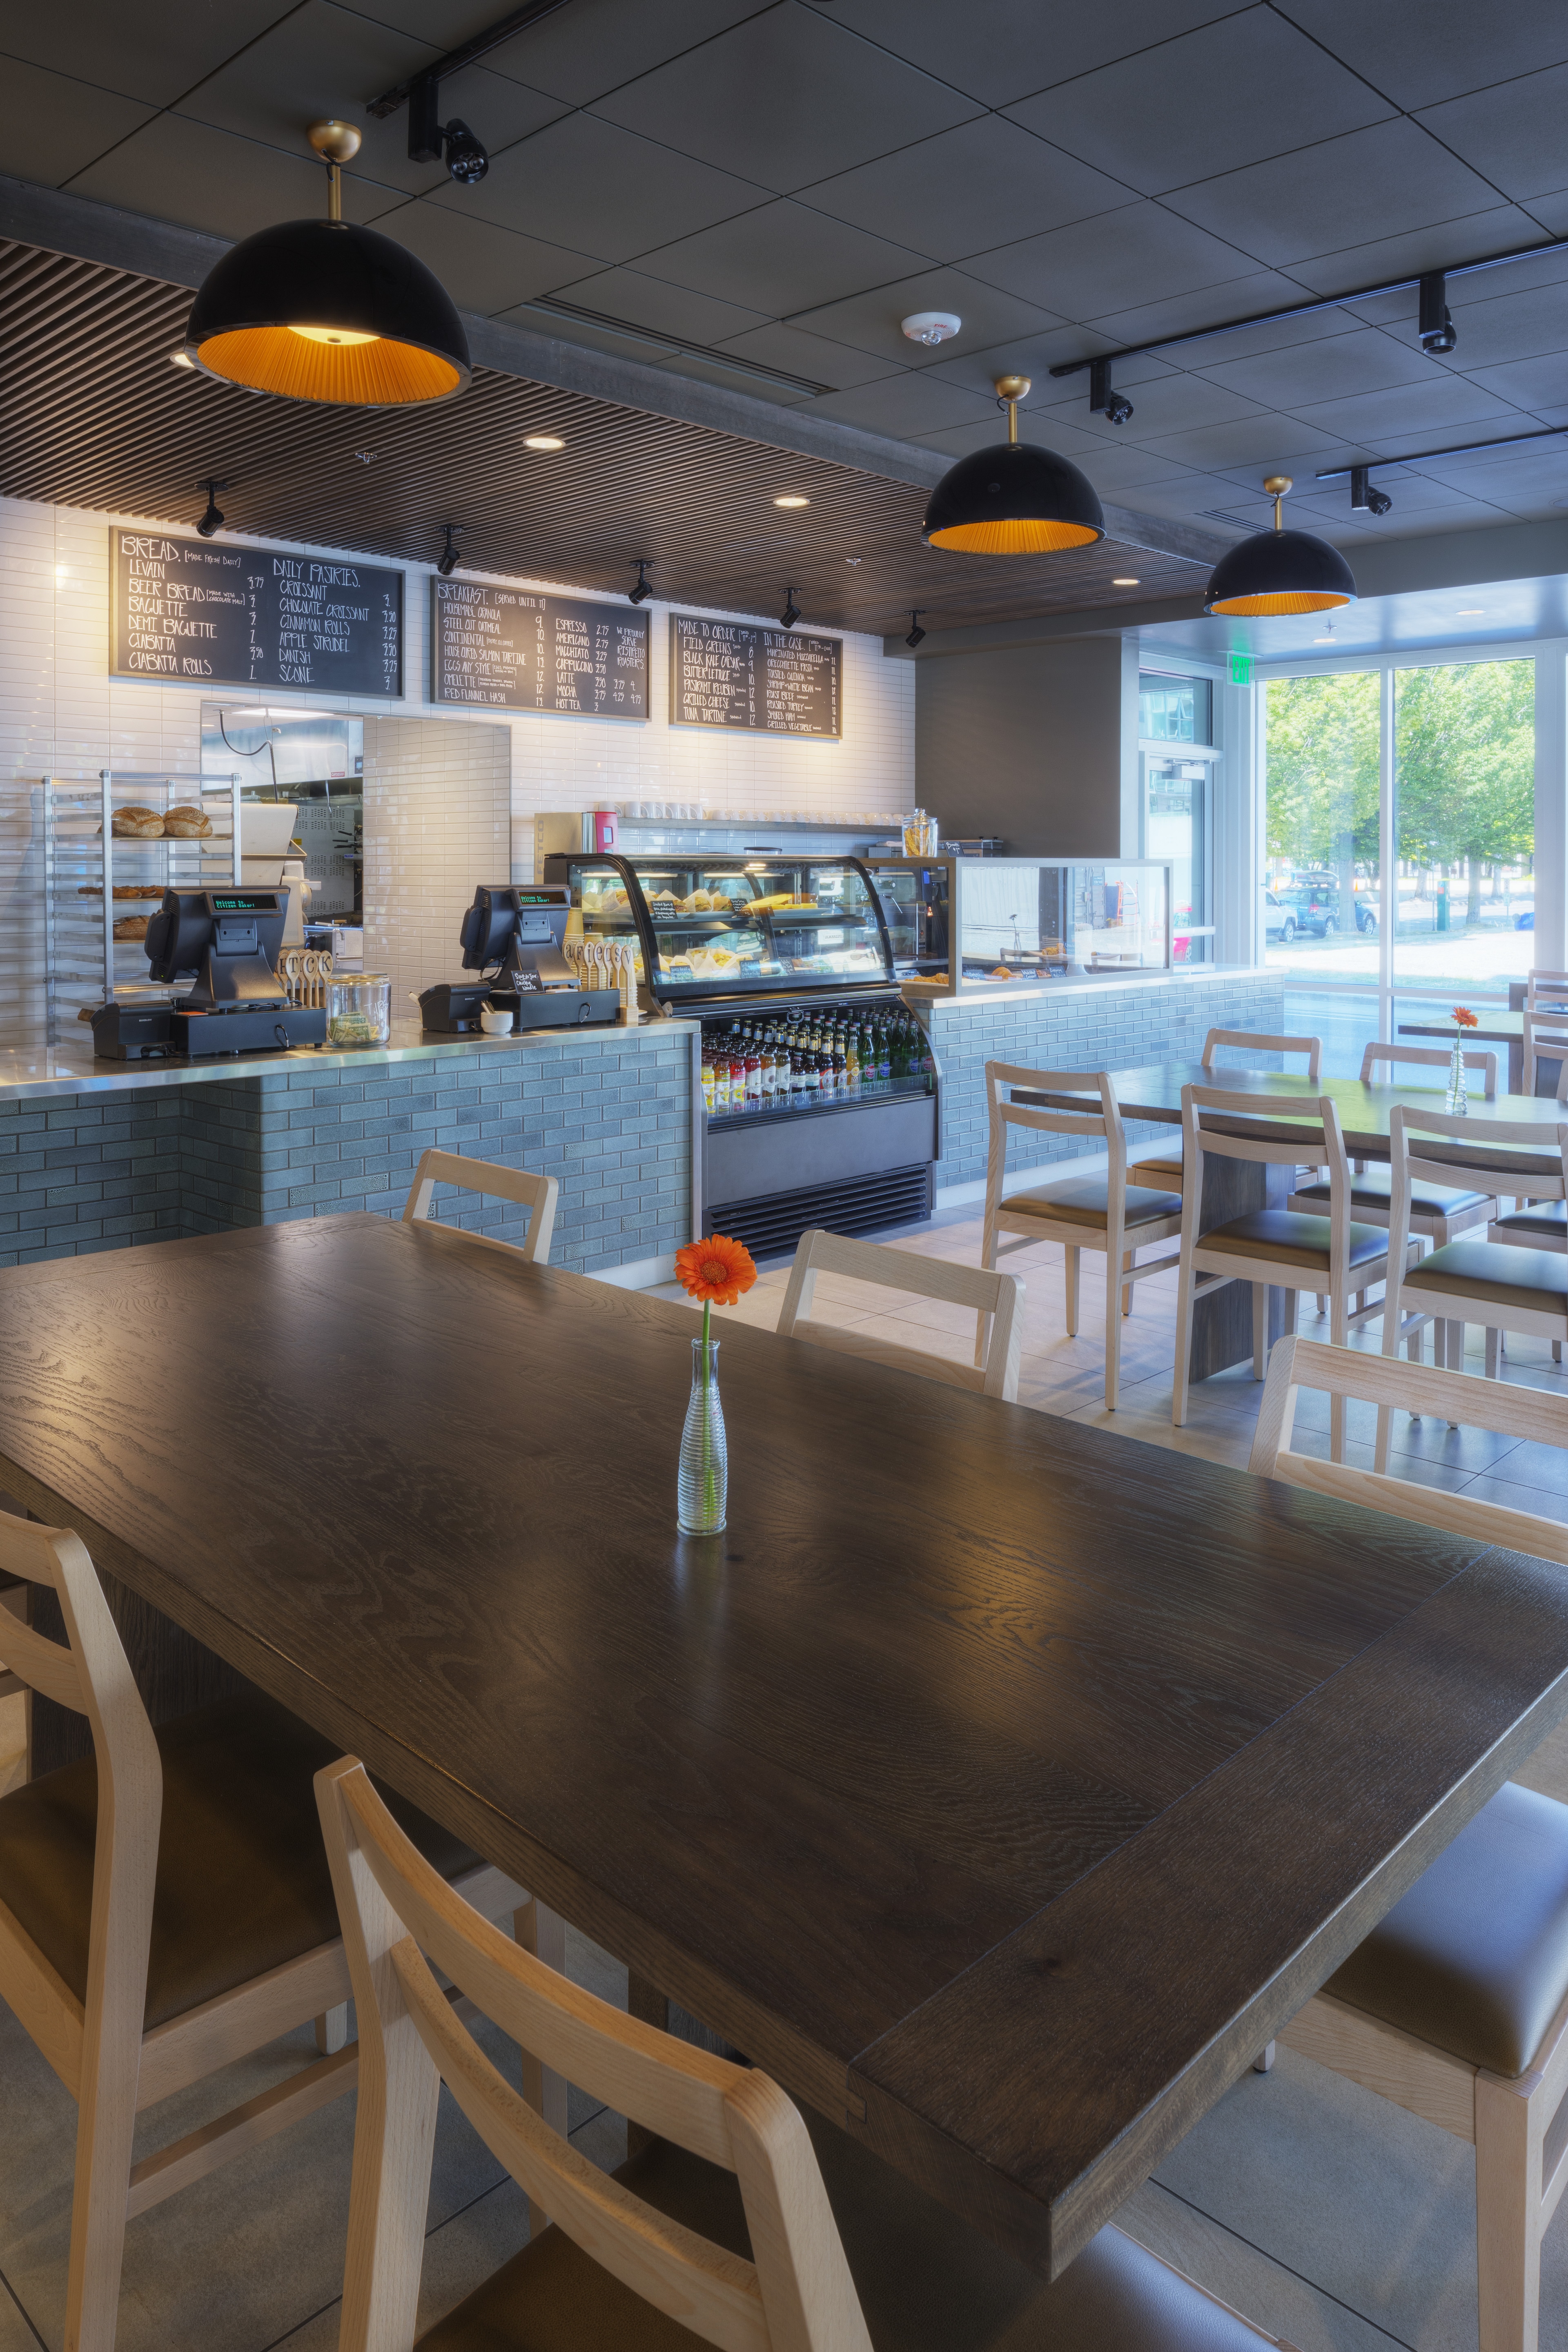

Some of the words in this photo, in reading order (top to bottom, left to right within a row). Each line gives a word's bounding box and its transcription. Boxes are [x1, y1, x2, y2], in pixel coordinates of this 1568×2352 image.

[122, 535, 180, 562] BREAD.
[130, 559, 165, 579] LEVAIN
[247, 576, 264, 589] 3.75
[274, 558, 303, 579] DAILY
[310, 564, 360, 587] PASTRIES.
[129, 578, 162, 597] BEER
[167, 583, 205, 602] BREAD
[280, 579, 327, 600] CROISSANT
[438, 583, 488, 605] BREAKFAST.
[519, 597, 536, 607] UNTIL
[129, 596, 188, 617] BAGUETTE
[280, 597, 323, 615] CHOCOLATE
[326, 604, 369, 621] CROISSANT
[382, 610, 396, 622] 3.50
[444, 602, 476, 617] HOUSEMADE
[478, 607, 501, 621] GRANOLA
[129, 614, 157, 632] DEMI
[163, 619, 217, 638] BAGUETTE
[280, 615, 321, 633] CINNAMON
[325, 620, 350, 635] ROLLS
[382, 626, 397, 640] 3.25
[443, 617, 463, 629] STEEL
[465, 619, 476, 630] CUT
[478, 621, 501, 634] OATMEAL
[556, 618, 587, 633] ESPRESSO
[596, 625, 609, 636] 2.75
[624, 628, 644, 639] PROUDLY
[678, 619, 699, 635] MADE
[700, 623, 709, 637] TO
[129, 633, 176, 653] CIABATTA
[280, 632, 307, 648] APPLE
[313, 635, 350, 653] STRUDEL
[382, 643, 396, 656] 3.50
[443, 631, 485, 646] CONTINENTAL
[556, 633, 589, 646] AMERICANO
[595, 639, 608, 649] 2.75
[621, 635, 637, 647] SERVE
[684, 636, 703, 650] FIELD
[706, 640, 731, 655] GREENS
[763, 632, 772, 646] IN
[774, 634, 787, 648] THE
[279, 648, 310, 664] DANISH
[383, 659, 397, 672] 3.25
[445, 645, 460, 658] HOUSE
[461, 646, 477, 659] CURED
[479, 649, 500, 662] SALMON
[501, 651, 526, 665] TARTINE
[555, 645, 589, 659] MACCHIATO
[595, 651, 607, 661] 3.25
[617, 645, 645, 658] RISTRETTO
[767, 648, 795, 659] MARINATED
[797, 652, 824, 664] MOZZARELLA
[129, 652, 178, 673] CIABATTA
[183, 657, 212, 675] ROLLS
[444, 659, 460, 672] EGGS
[462, 662, 473, 673] ANY
[475, 662, 491, 675] STYLE
[556, 658, 593, 673] CAPPUCCINO
[595, 664, 606, 674] 3.50
[684, 650, 703, 665] BLACK
[706, 653, 720, 670] KALE
[721, 655, 740, 671] CAESAR
[767, 659, 799, 670] ORECCHIETTE
[800, 663, 813, 673] PASTA
[279, 664, 315, 684] SCONE
[684, 665, 707, 679] BUTTER
[708, 668, 731, 682] LETTUCE
[767, 669, 785, 679] TOASTED
[787, 672, 806, 682] QUINOA
[1232, 655, 1250, 685] EXIT
[444, 674, 476, 688] OMELETTE
[557, 672, 575, 684] LATTE
[595, 677, 606, 688] 3.50
[613, 679, 625, 689] 3.75
[684, 679, 711, 693] PASTRAMI
[713, 683, 735, 696] REUBEN
[767, 679, 784, 689] SHRIMP
[787, 682, 800, 691] WHITE
[802, 684, 813, 693] BEAN
[444, 688, 460, 699] RED
[461, 689, 488, 702] FLANNEL
[490, 692, 506, 703] HASH
[557, 685, 577, 697] MOCHA
[595, 689, 606, 700] 3.75
[683, 693, 707, 706] GRILLED
[708, 696, 730, 709] CHEESE
[766, 689, 780, 699] ROAST
[781, 691, 794, 701] BEEF
[556, 698, 568, 709] HOT
[568, 699, 581, 710] TEA
[767, 699, 786, 710] ROASTED
[787, 702, 804, 712] TURKEY
[684, 706, 699, 721] TUNA
[702, 708, 727, 723] TARTINE
[767, 710, 784, 720] SMOKED
[785, 712, 795, 721] HAM
[767, 720, 787, 729] GRILLED
[788, 722, 813, 732] VEGETABLE
[363, 1000, 388, 1018] TIPS
